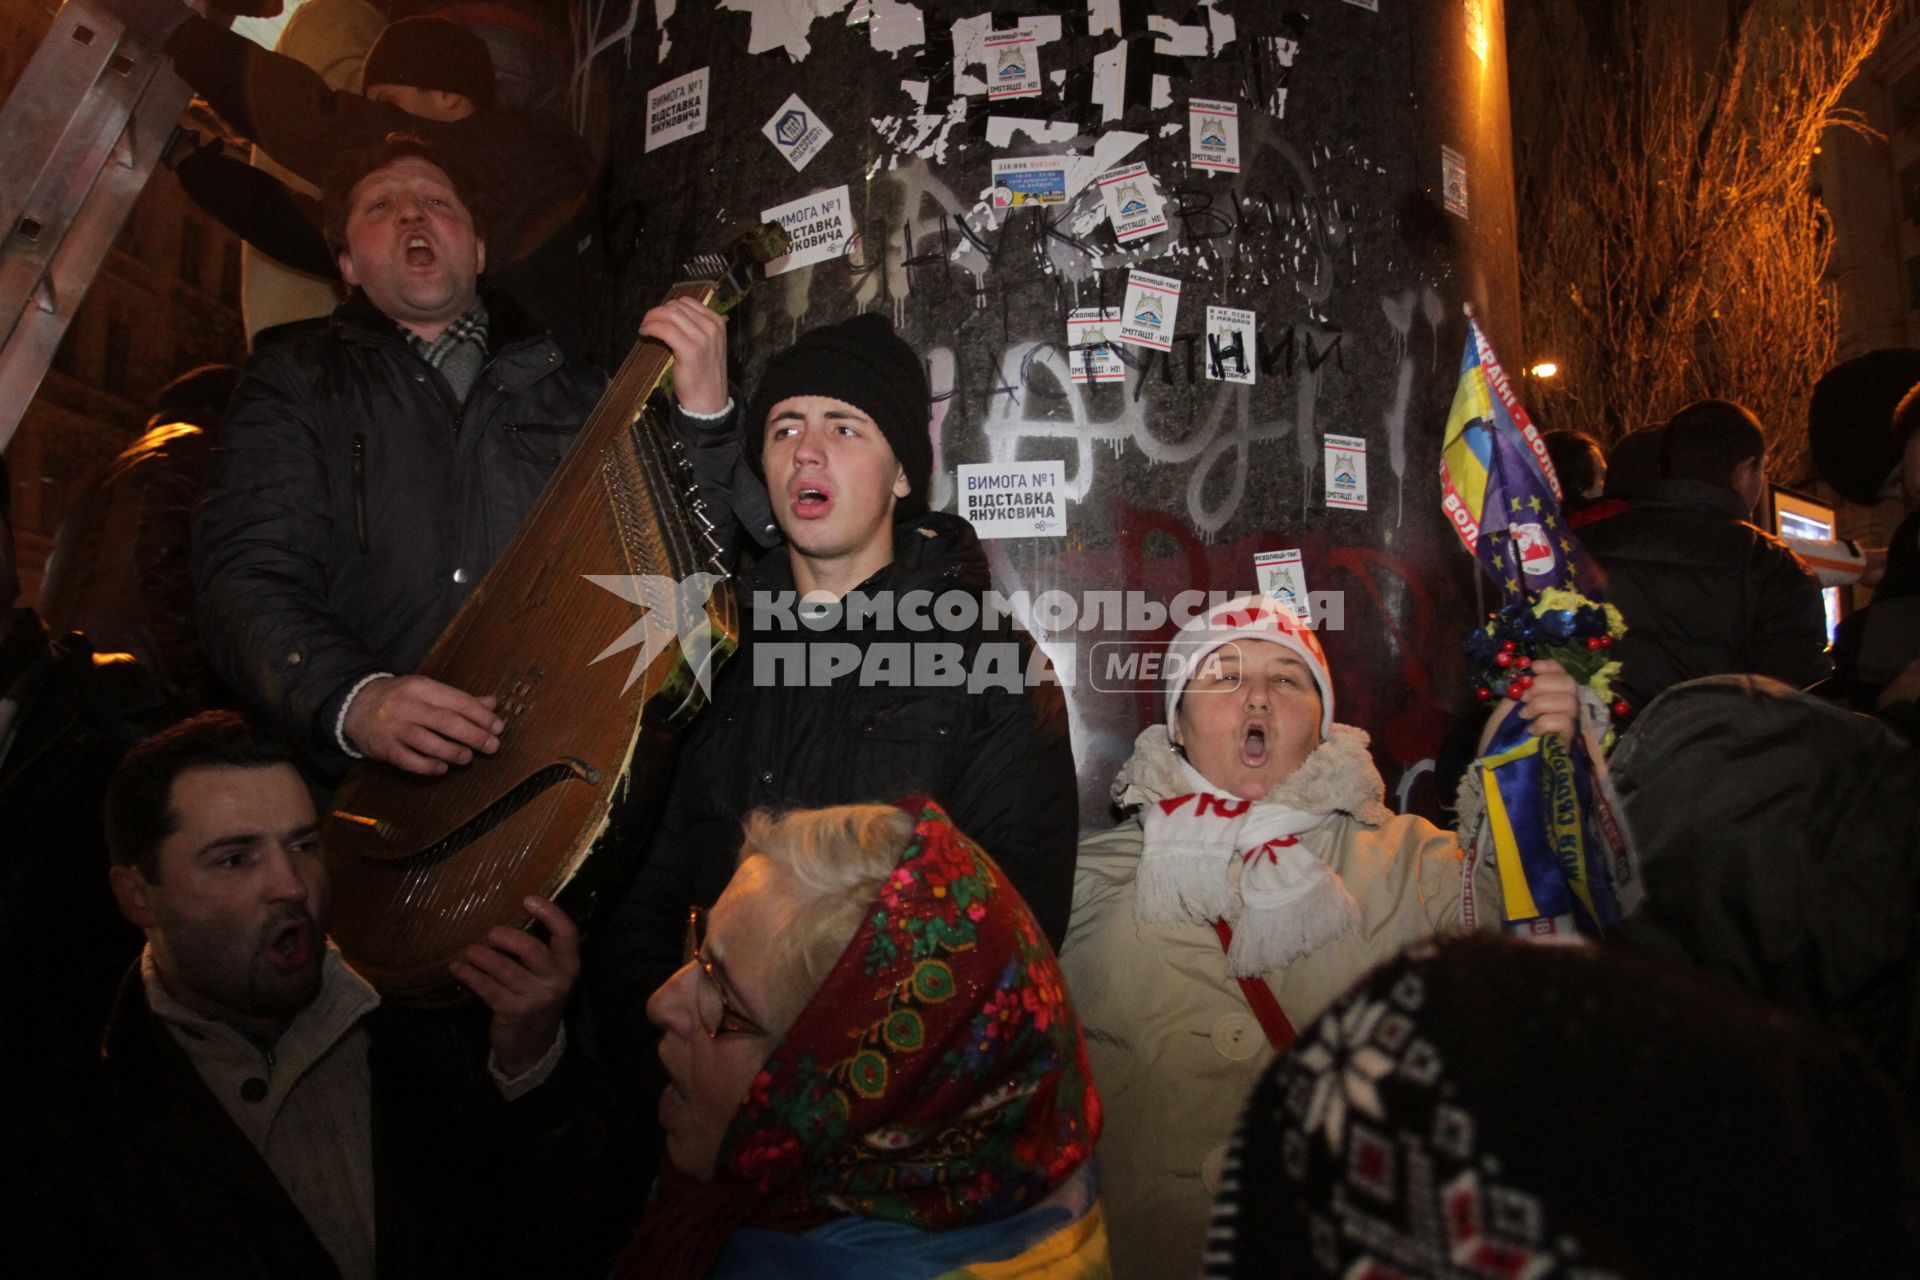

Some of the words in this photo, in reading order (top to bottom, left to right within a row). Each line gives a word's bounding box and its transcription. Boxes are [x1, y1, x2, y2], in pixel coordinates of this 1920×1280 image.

[651, 86, 686, 110] ВИМОГА
[651, 95, 701, 124] ВІДСТАВКА
[651, 107, 700, 136] ЯНУКОВИЧА
[776, 205, 818, 228] ИМОГА
[785, 216, 842, 242] ДСТАВКА
[786, 229, 844, 256] УКОВИЧА
[1121, 327, 1154, 341] ІМІТАЦІЇ
[1071, 365, 1104, 375] ІМІЦІЇ
[967, 474, 1028, 490] ВИМОГА
[968, 492, 1056, 508] ВІДСТАВКА
[969, 506, 1056, 521] ЯНУКОВИЧА
